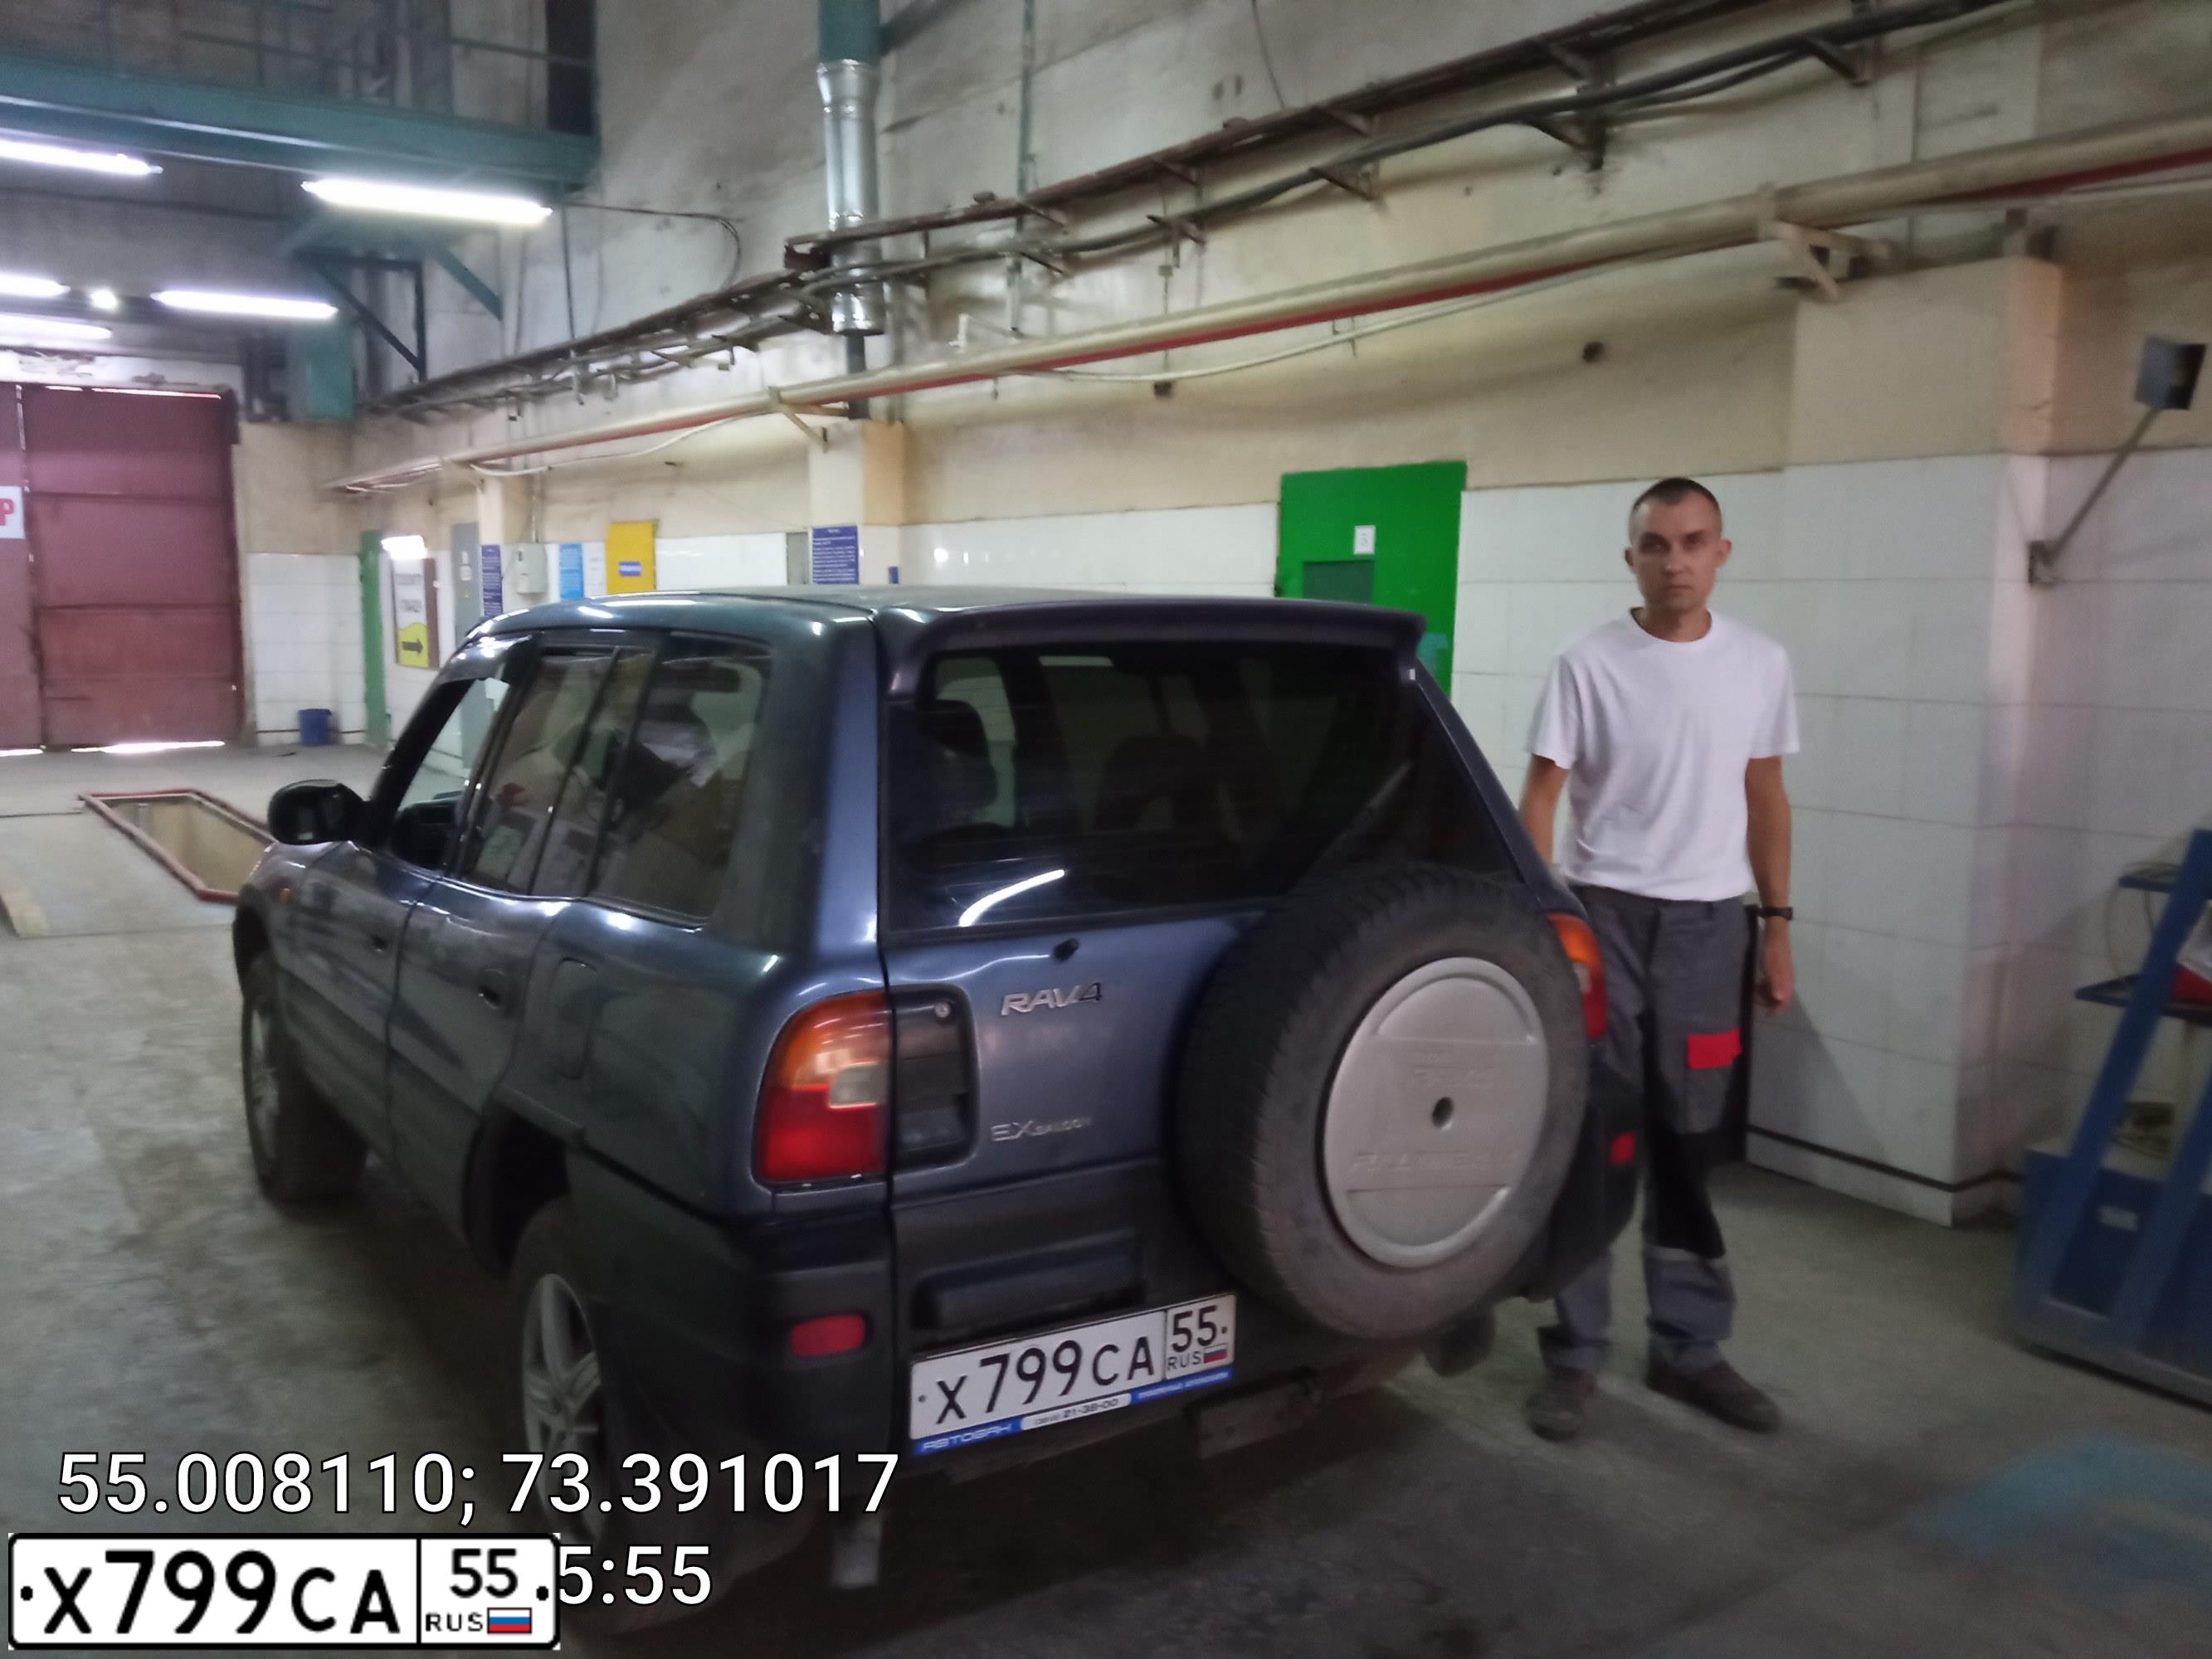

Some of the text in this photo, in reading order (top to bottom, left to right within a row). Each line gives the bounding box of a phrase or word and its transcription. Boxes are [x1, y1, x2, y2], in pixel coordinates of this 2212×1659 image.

[1001, 982, 1102, 1015] RAV4
[935, 1335, 1156, 1425] Х799СА
[1171, 1305, 1218, 1353] 55
[1167, 1346, 1202, 1372] RUS
